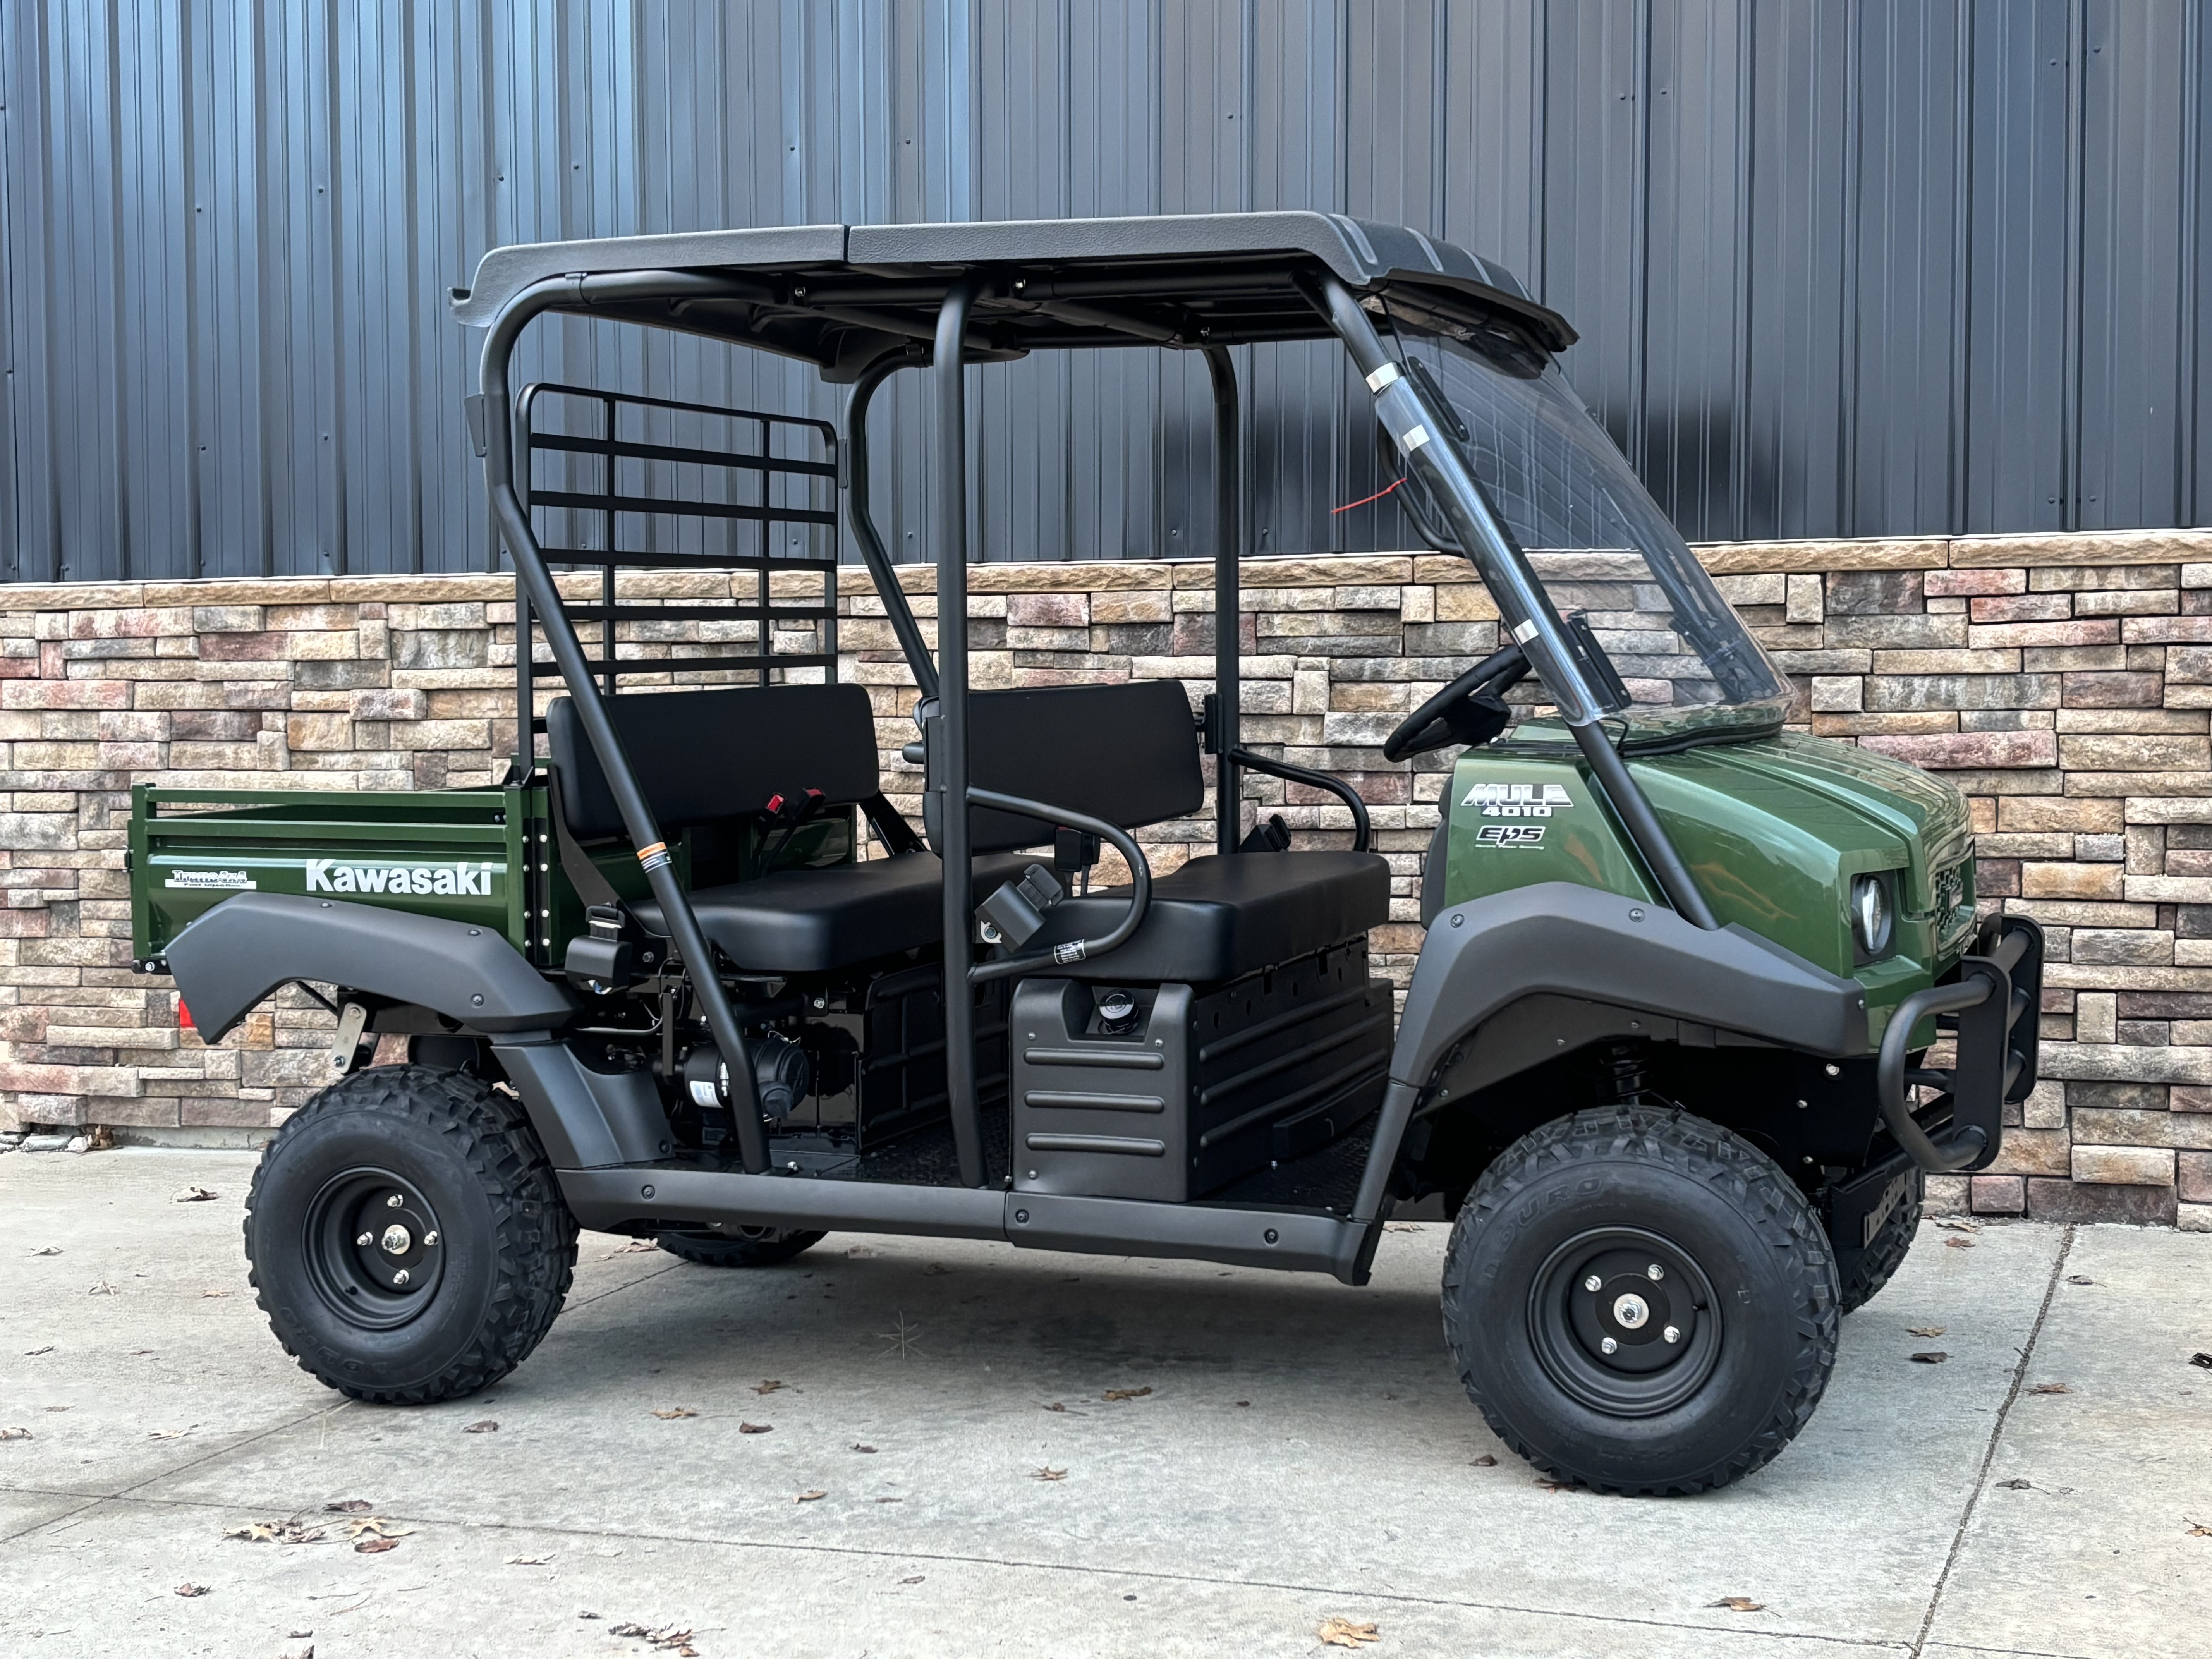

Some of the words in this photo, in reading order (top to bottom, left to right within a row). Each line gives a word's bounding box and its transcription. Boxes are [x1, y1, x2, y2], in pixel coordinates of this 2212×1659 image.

[1460, 784, 1574, 807] MULE
[1482, 807, 1552, 817] 4010
[306, 859, 493, 895] Kawasaki
